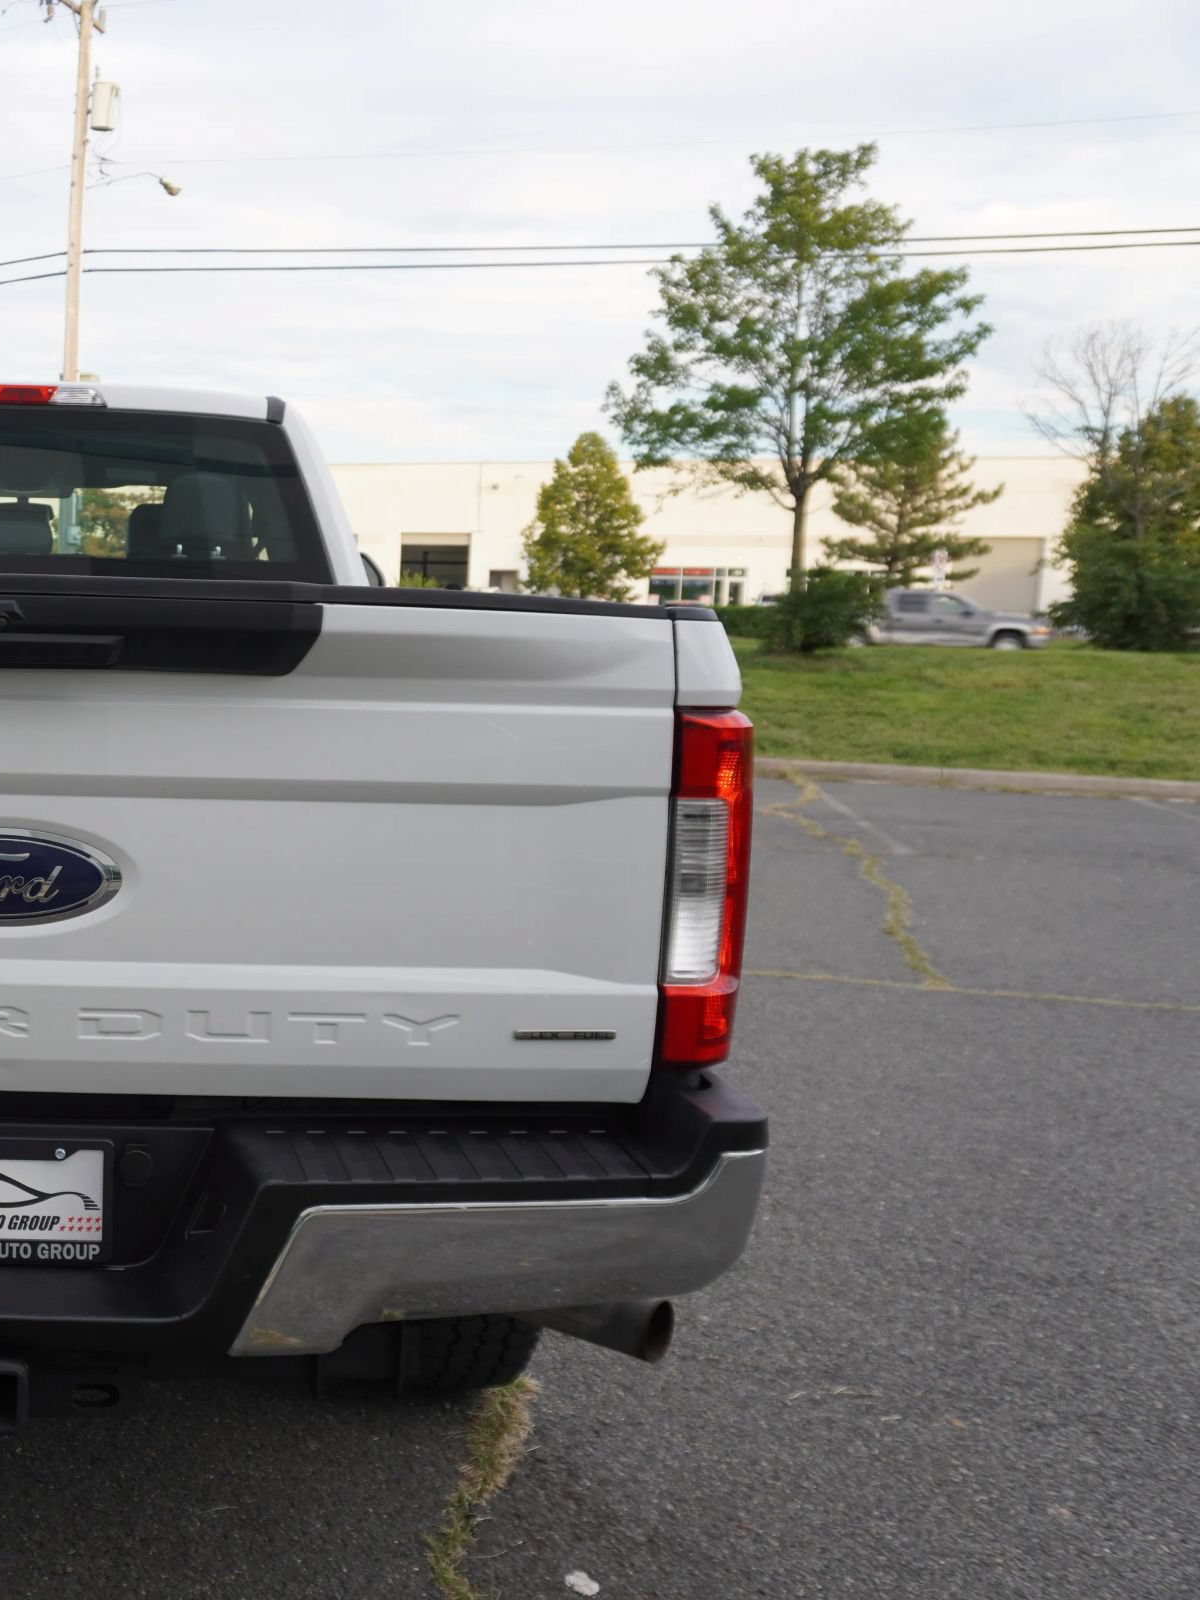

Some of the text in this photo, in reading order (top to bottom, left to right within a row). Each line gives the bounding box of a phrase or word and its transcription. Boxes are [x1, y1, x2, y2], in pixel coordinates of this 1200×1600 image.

[77, 1007, 461, 1046] DUTY
[7, 1214, 61, 1231] GROUP
[36, 1242, 100, 1261] GROUP
